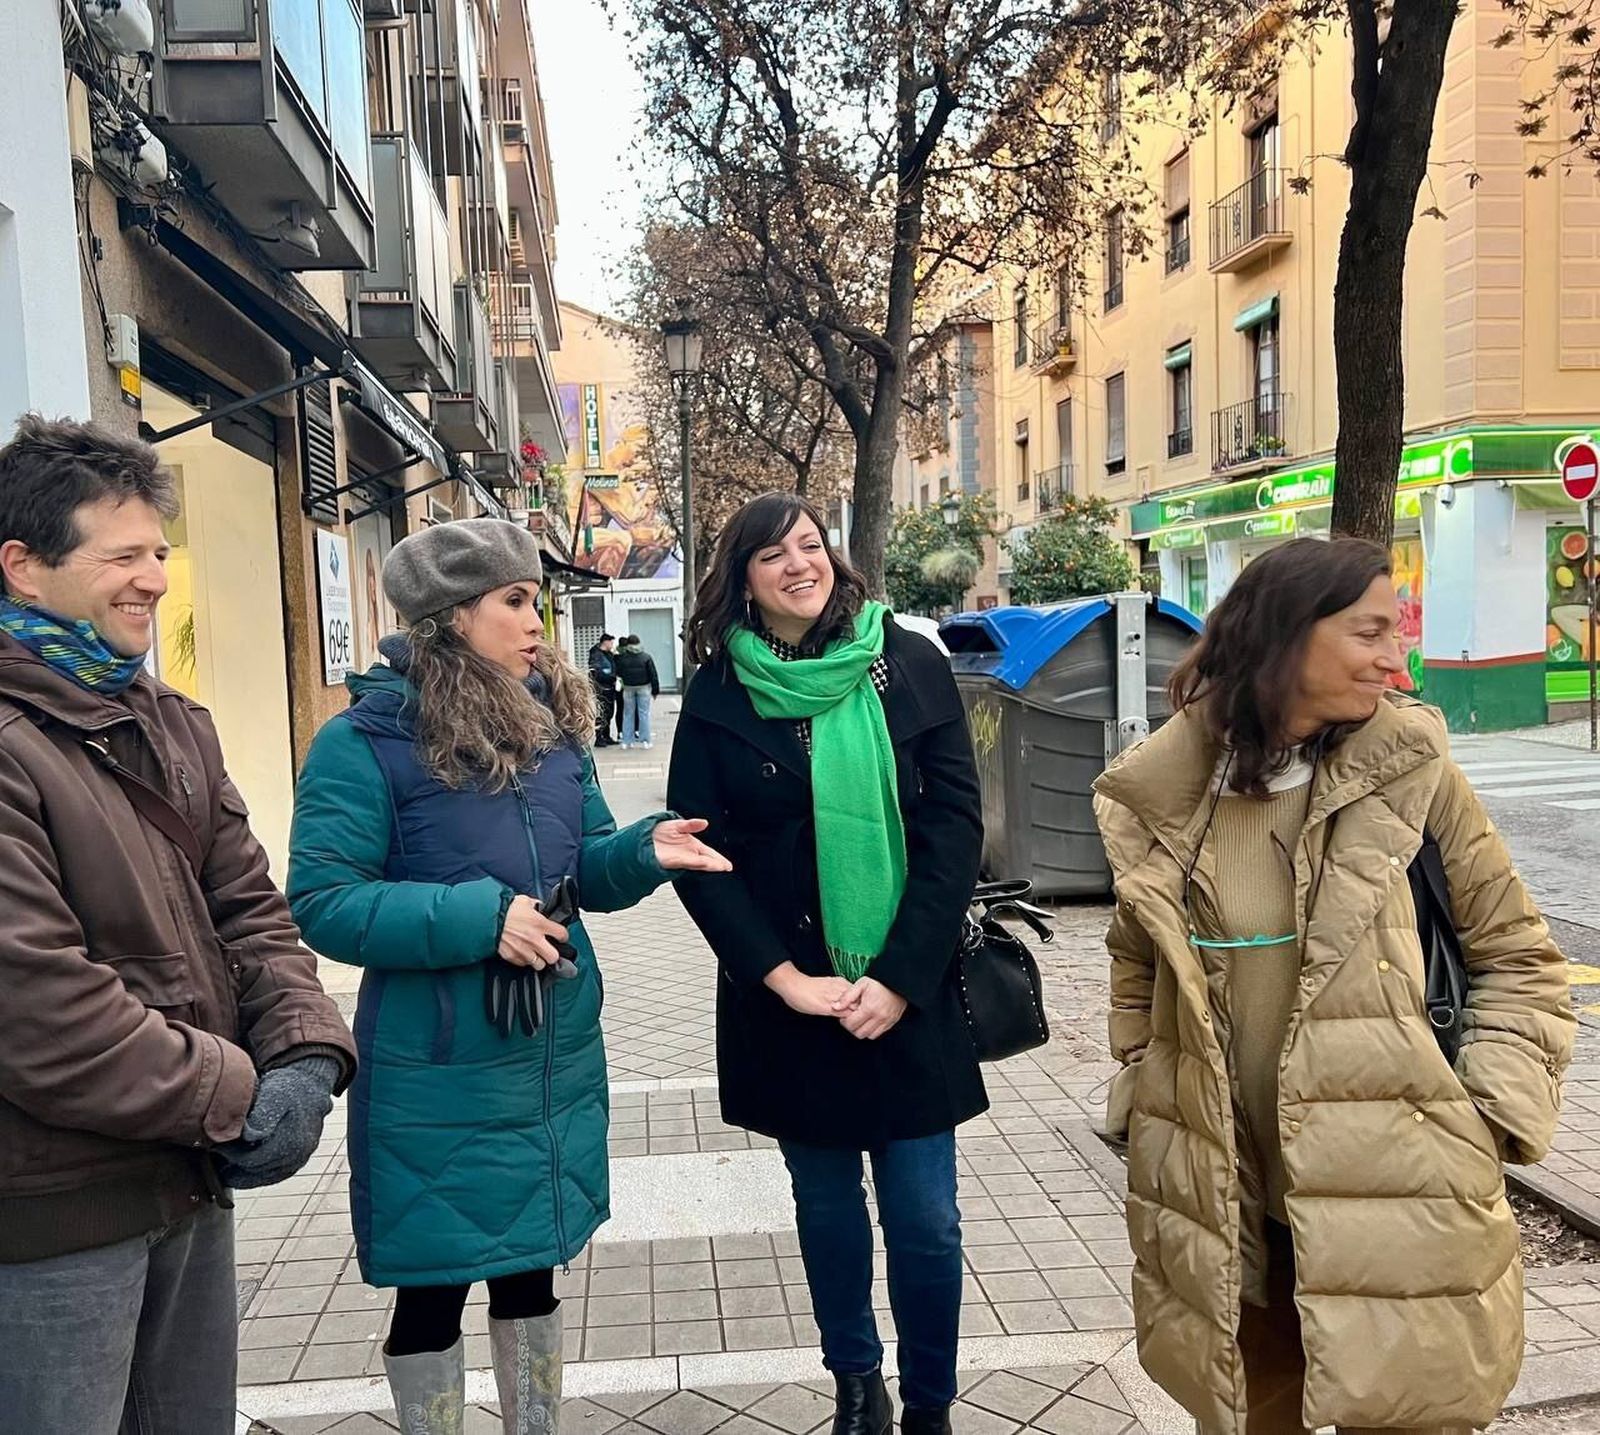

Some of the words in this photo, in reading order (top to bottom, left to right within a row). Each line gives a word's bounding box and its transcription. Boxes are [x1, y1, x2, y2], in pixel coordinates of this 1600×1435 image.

[585, 385, 599, 454] HOTEL
[619, 595, 677, 604] PARAFARMACIA
[328, 618, 350, 665] 69€
